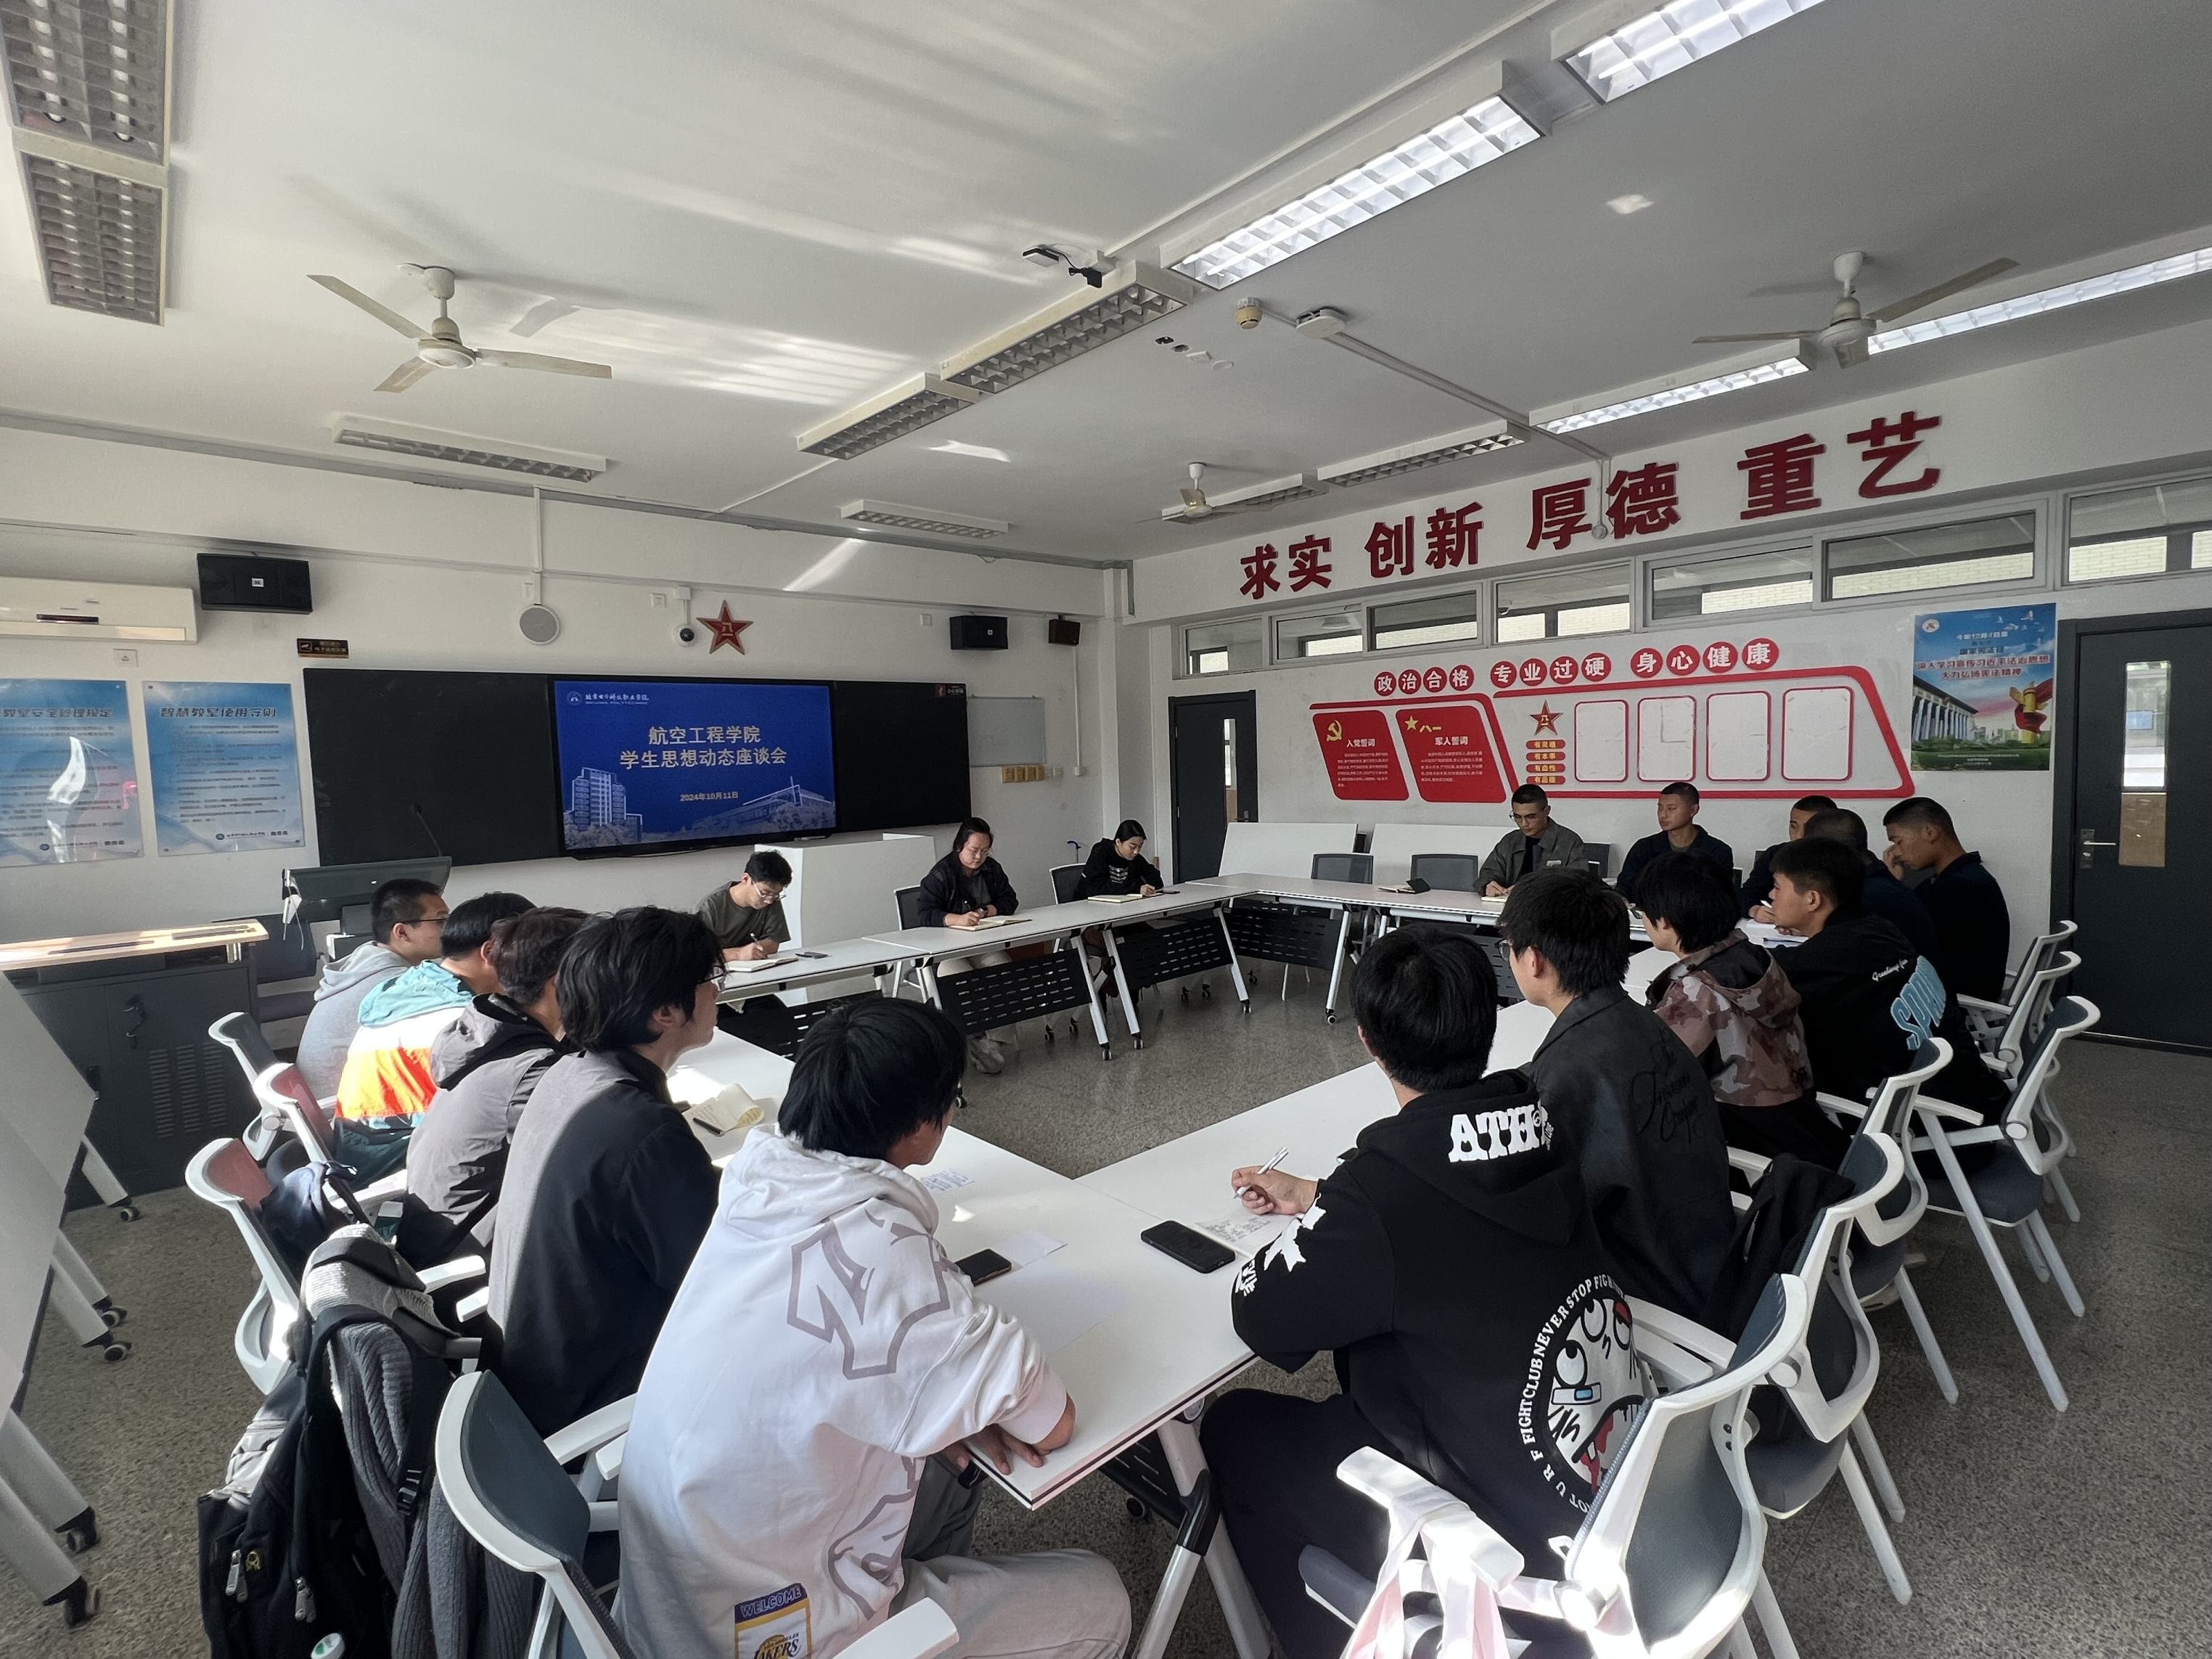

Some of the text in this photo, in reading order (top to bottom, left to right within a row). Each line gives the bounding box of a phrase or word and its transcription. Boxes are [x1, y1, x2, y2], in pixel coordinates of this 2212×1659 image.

[1240, 411, 1941, 599] 求实 创新 厚德 重艺
[1377, 642, 1771, 692] 政治合格 专业过硬 身心健康
[0, 708, 112, 718] 教室安全管理规定
[161, 707, 276, 718] 智慧教室使用守则
[648, 726, 761, 745] 航空工程学院
[1346, 738, 1376, 748] 入党誓词
[1434, 736, 1468, 746] 军人誓词
[620, 747, 787, 770] 学生思想动态座谈会
[680, 791, 739, 802] 2024年10月11日
[1566, 1279, 1592, 1309] STOP
[1533, 1305, 1569, 1358] NEVER
[1523, 1358, 1543, 1399] CLUB
[1518, 1399, 1536, 1445] FIGHT
[740, 1586, 802, 1618] WELCOME
